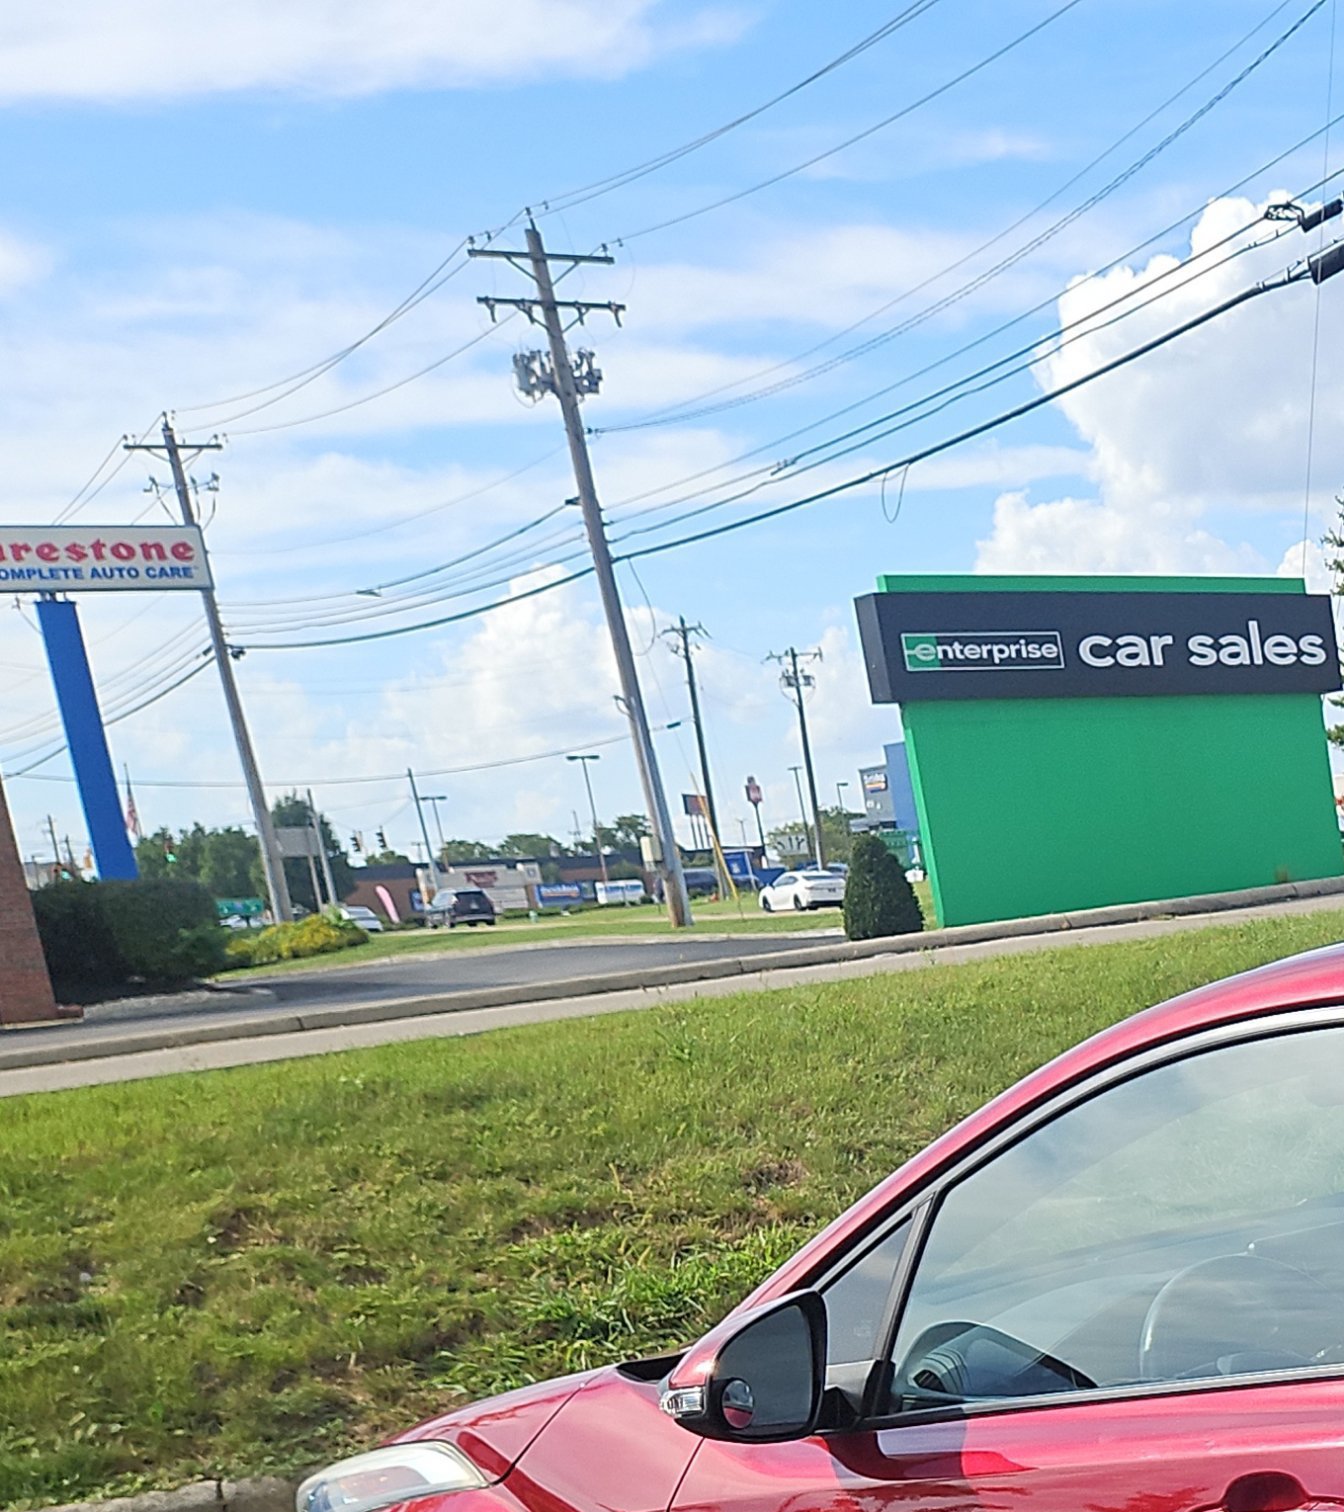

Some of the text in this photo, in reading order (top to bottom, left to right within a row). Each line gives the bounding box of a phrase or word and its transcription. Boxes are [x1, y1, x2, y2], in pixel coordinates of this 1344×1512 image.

[90, 566, 140, 579] AUTO
[145, 565, 194, 579] CARE
[908, 620, 1328, 667] enterprise car sales
